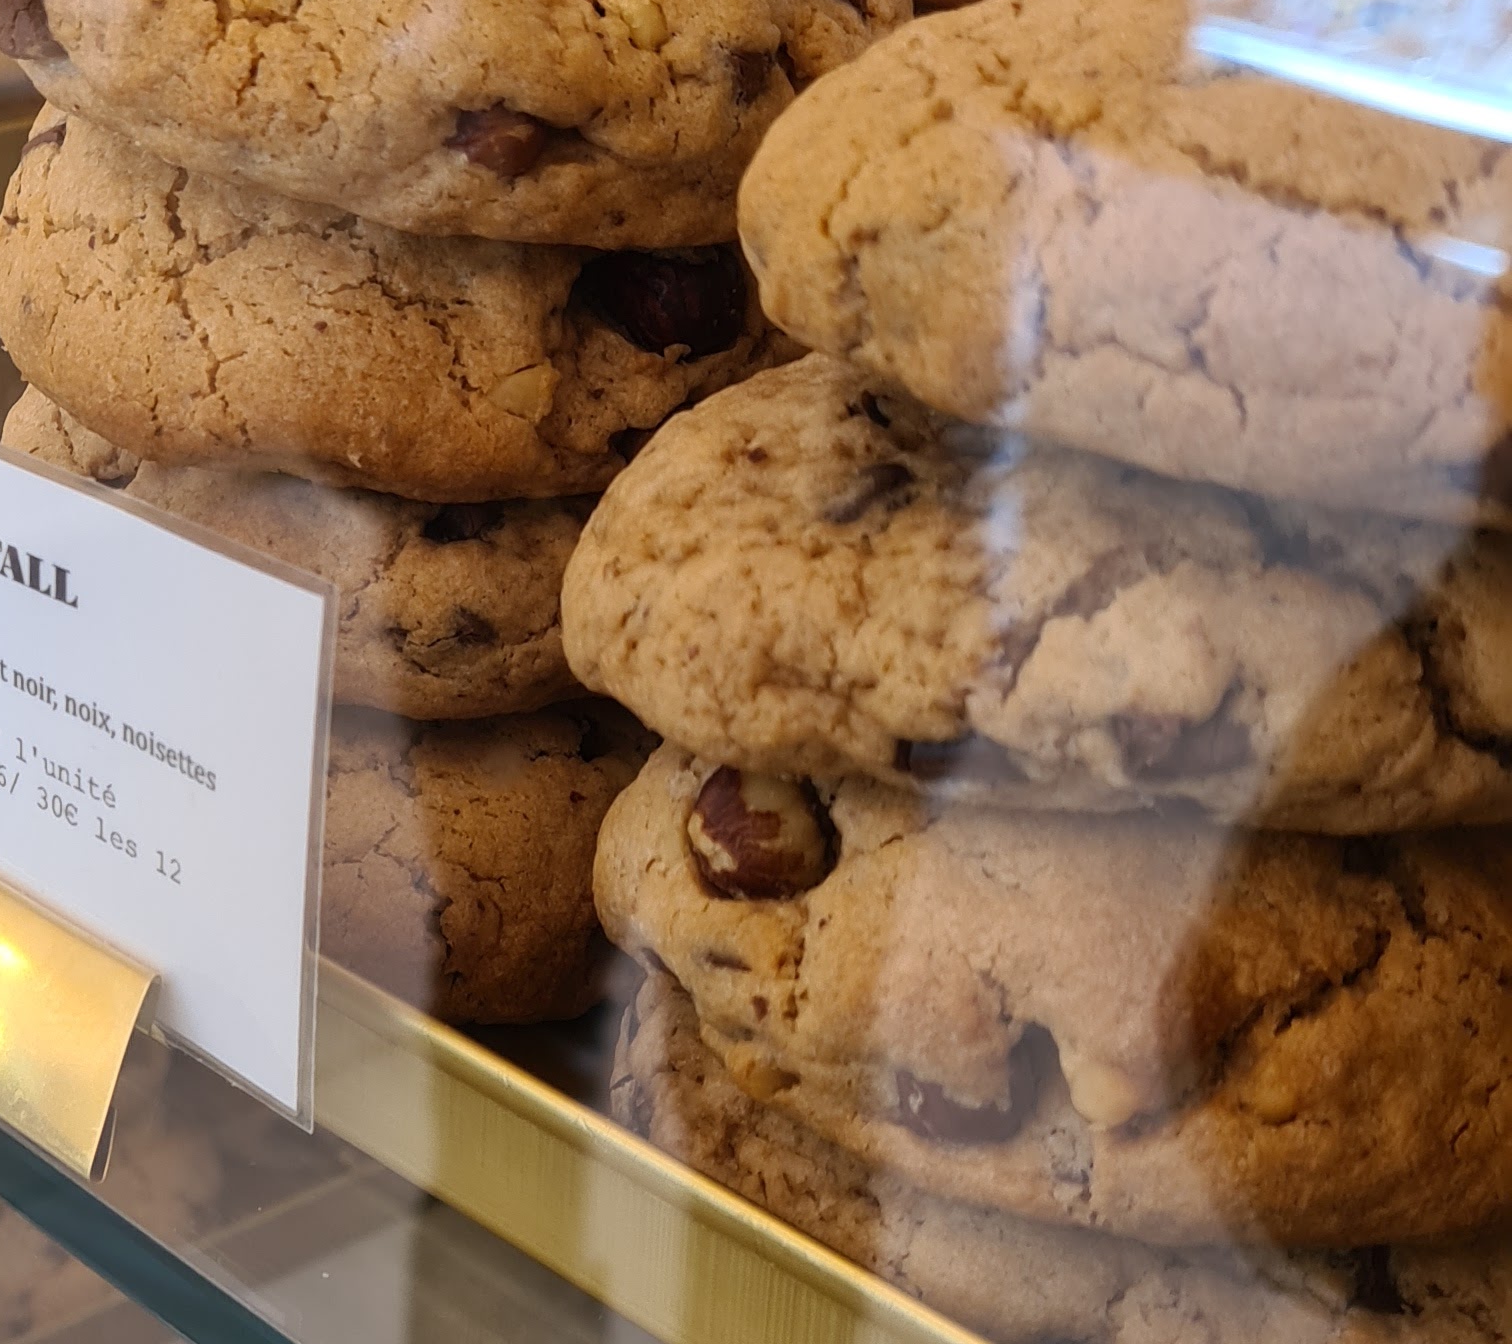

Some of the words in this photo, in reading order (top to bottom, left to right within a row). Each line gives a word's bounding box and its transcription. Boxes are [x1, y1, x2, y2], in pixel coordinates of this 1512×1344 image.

[13, 667, 59, 710] noir,
[64, 693, 117, 739] noix,
[122, 722, 218, 792] noisettes
[15, 736, 117, 809] l'unité
[36, 785, 80, 827] 30€
[94, 816, 138, 859] les
[155, 850, 183, 885] 12
